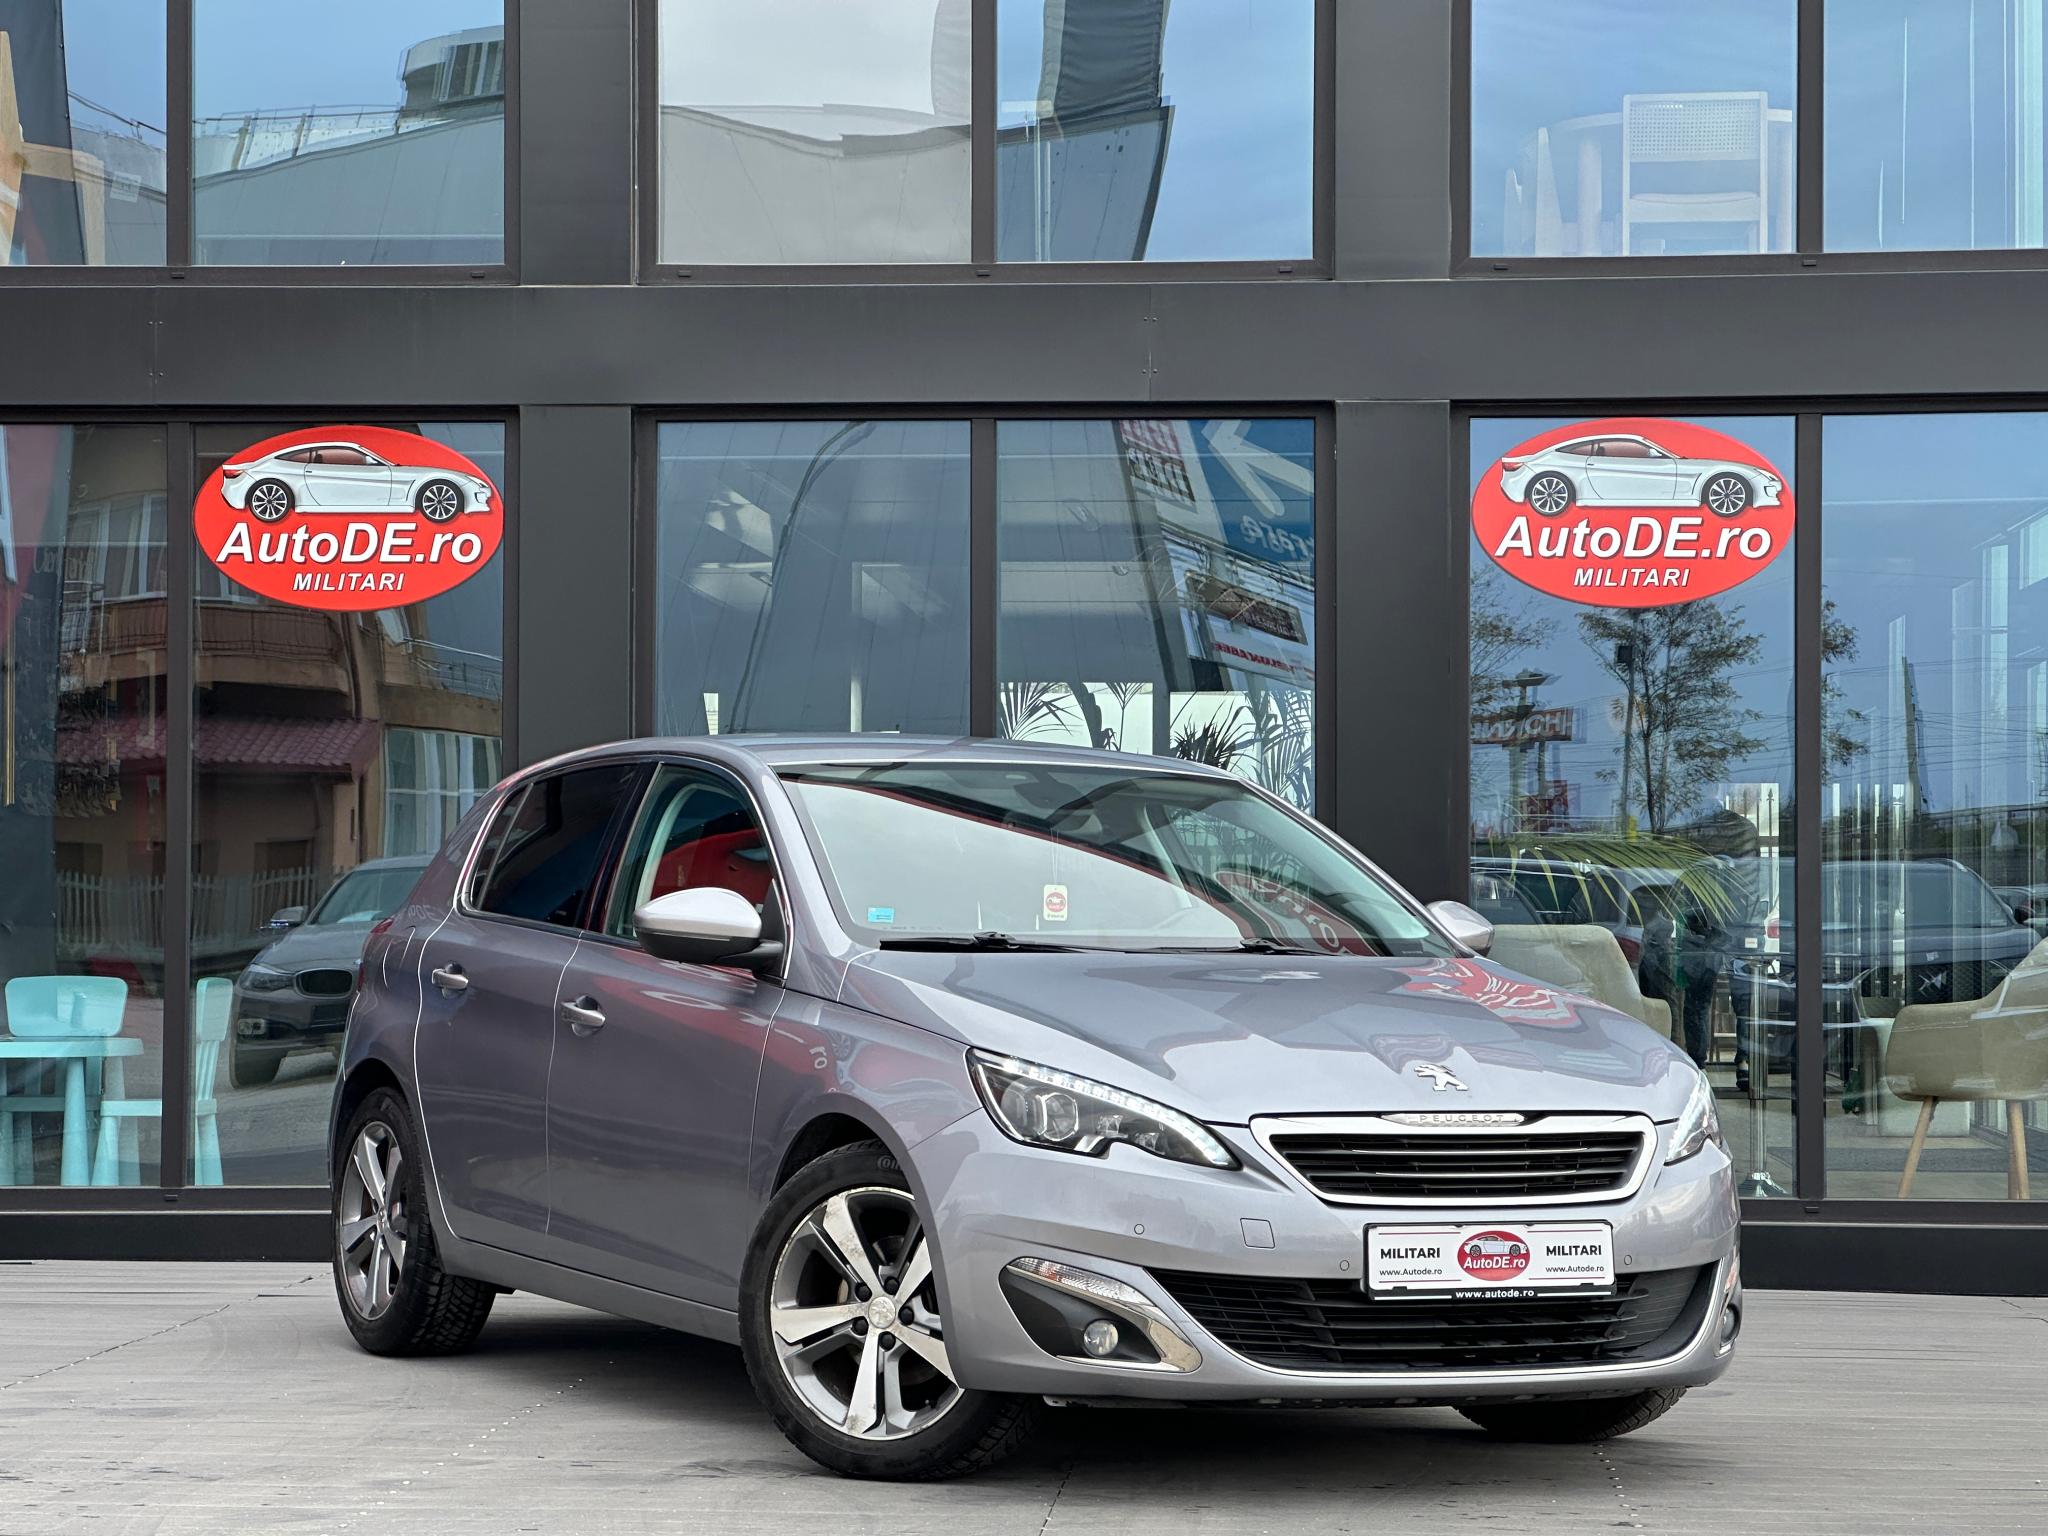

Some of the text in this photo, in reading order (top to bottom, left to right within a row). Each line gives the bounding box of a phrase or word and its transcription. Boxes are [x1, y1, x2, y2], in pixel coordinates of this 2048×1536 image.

[215, 522, 483, 564] AutoDE.ro
[1494, 515, 1772, 559] AutoDE.ro
[292, 572, 406, 592] MILITARI
[1573, 567, 1691, 588] MILITARI
[1419, 1114, 1504, 1123] PEUGEOT
[1380, 1247, 1441, 1260] MILITARI
[1545, 1244, 1602, 1257] MILITARI
[1463, 1255, 1526, 1270] AutoDE.ro
[1545, 1264, 1605, 1273] www.Autode.ro
[1379, 1267, 1443, 1277] www.Autode.ro
[1455, 1288, 1535, 1299] www.autode.ro
